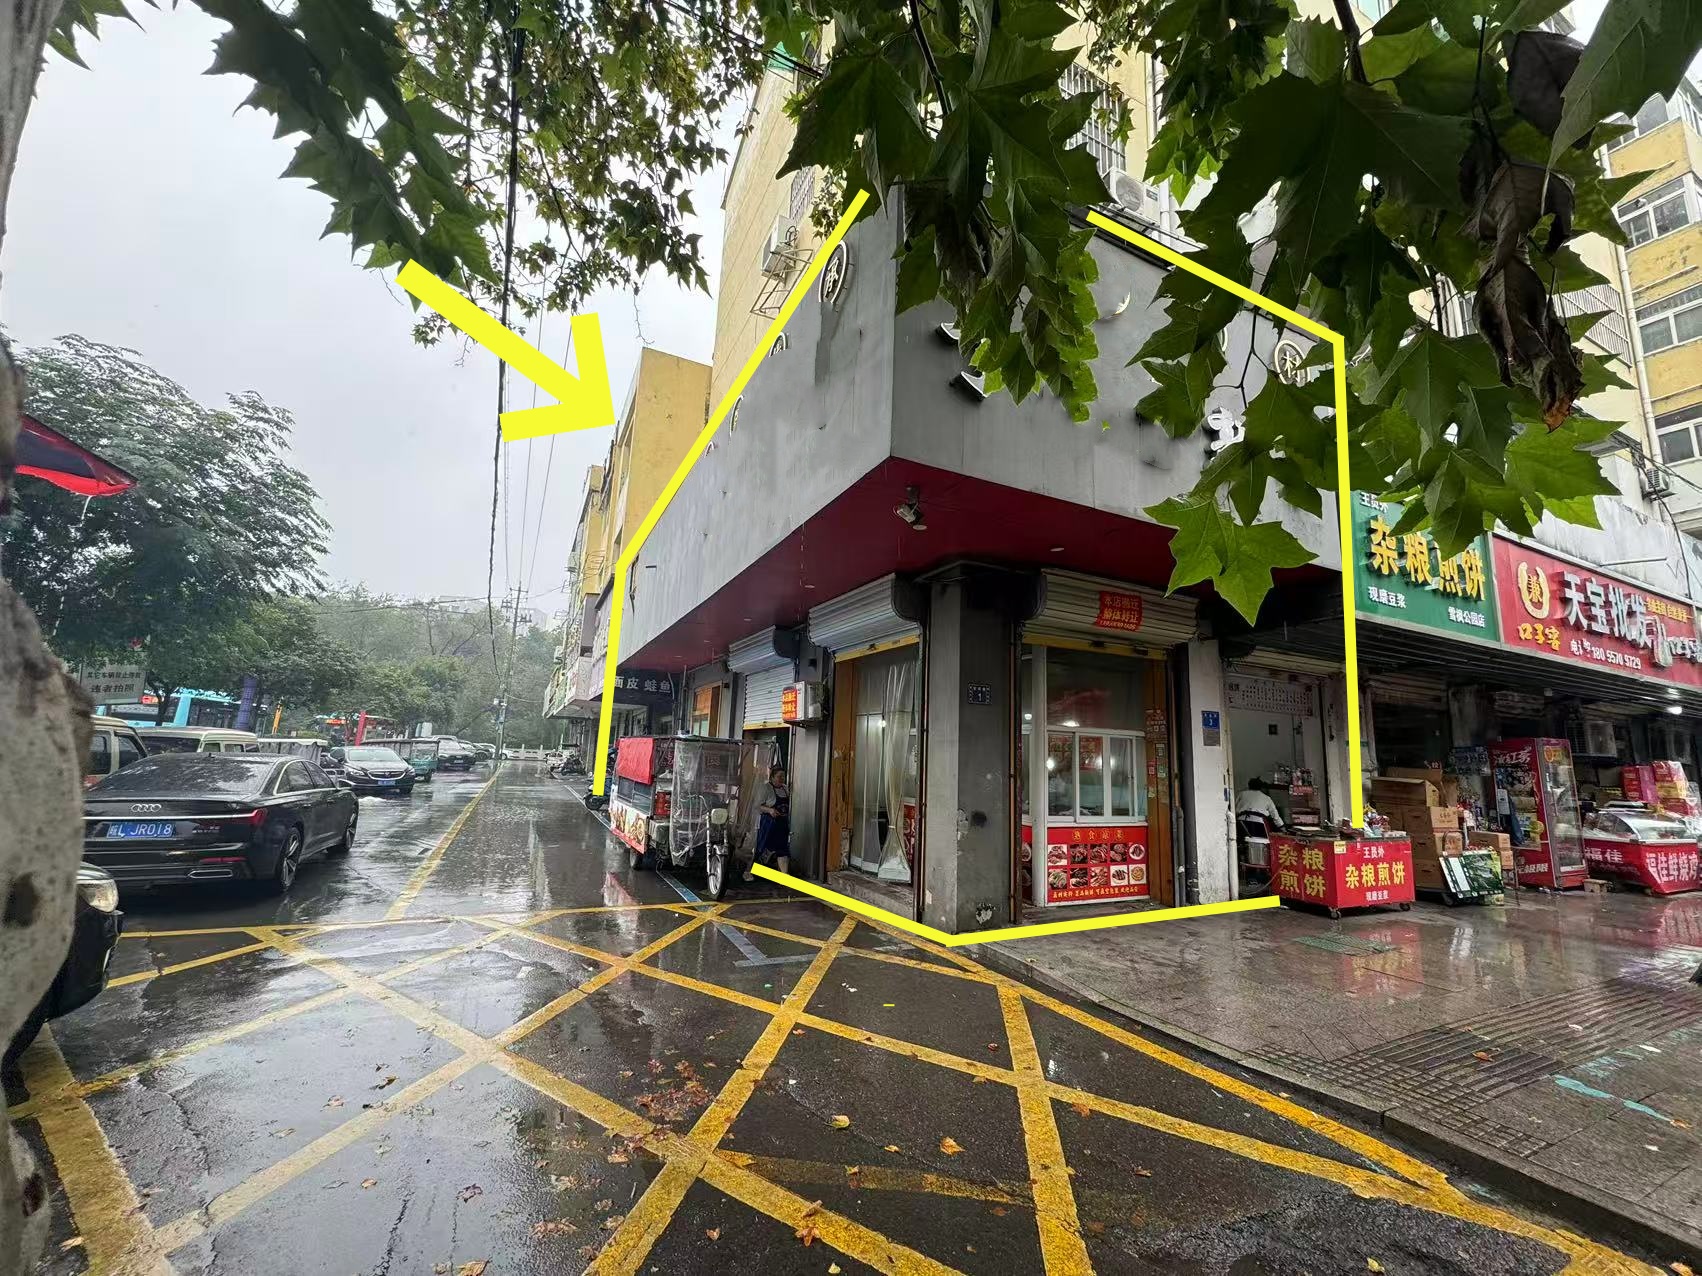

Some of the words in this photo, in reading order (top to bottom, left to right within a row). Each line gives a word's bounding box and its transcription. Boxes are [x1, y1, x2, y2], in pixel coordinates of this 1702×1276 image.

[1368, 586, 1406, 608] 现磨豆浆
[1279, 844, 1325, 871] 杂粮
[1363, 845, 1385, 859] 王员外
[1584, 847, 1623, 864] 福佳
[1279, 869, 1326, 898] 煎饼
[1345, 861, 1406, 889] 杂粮煎饼
